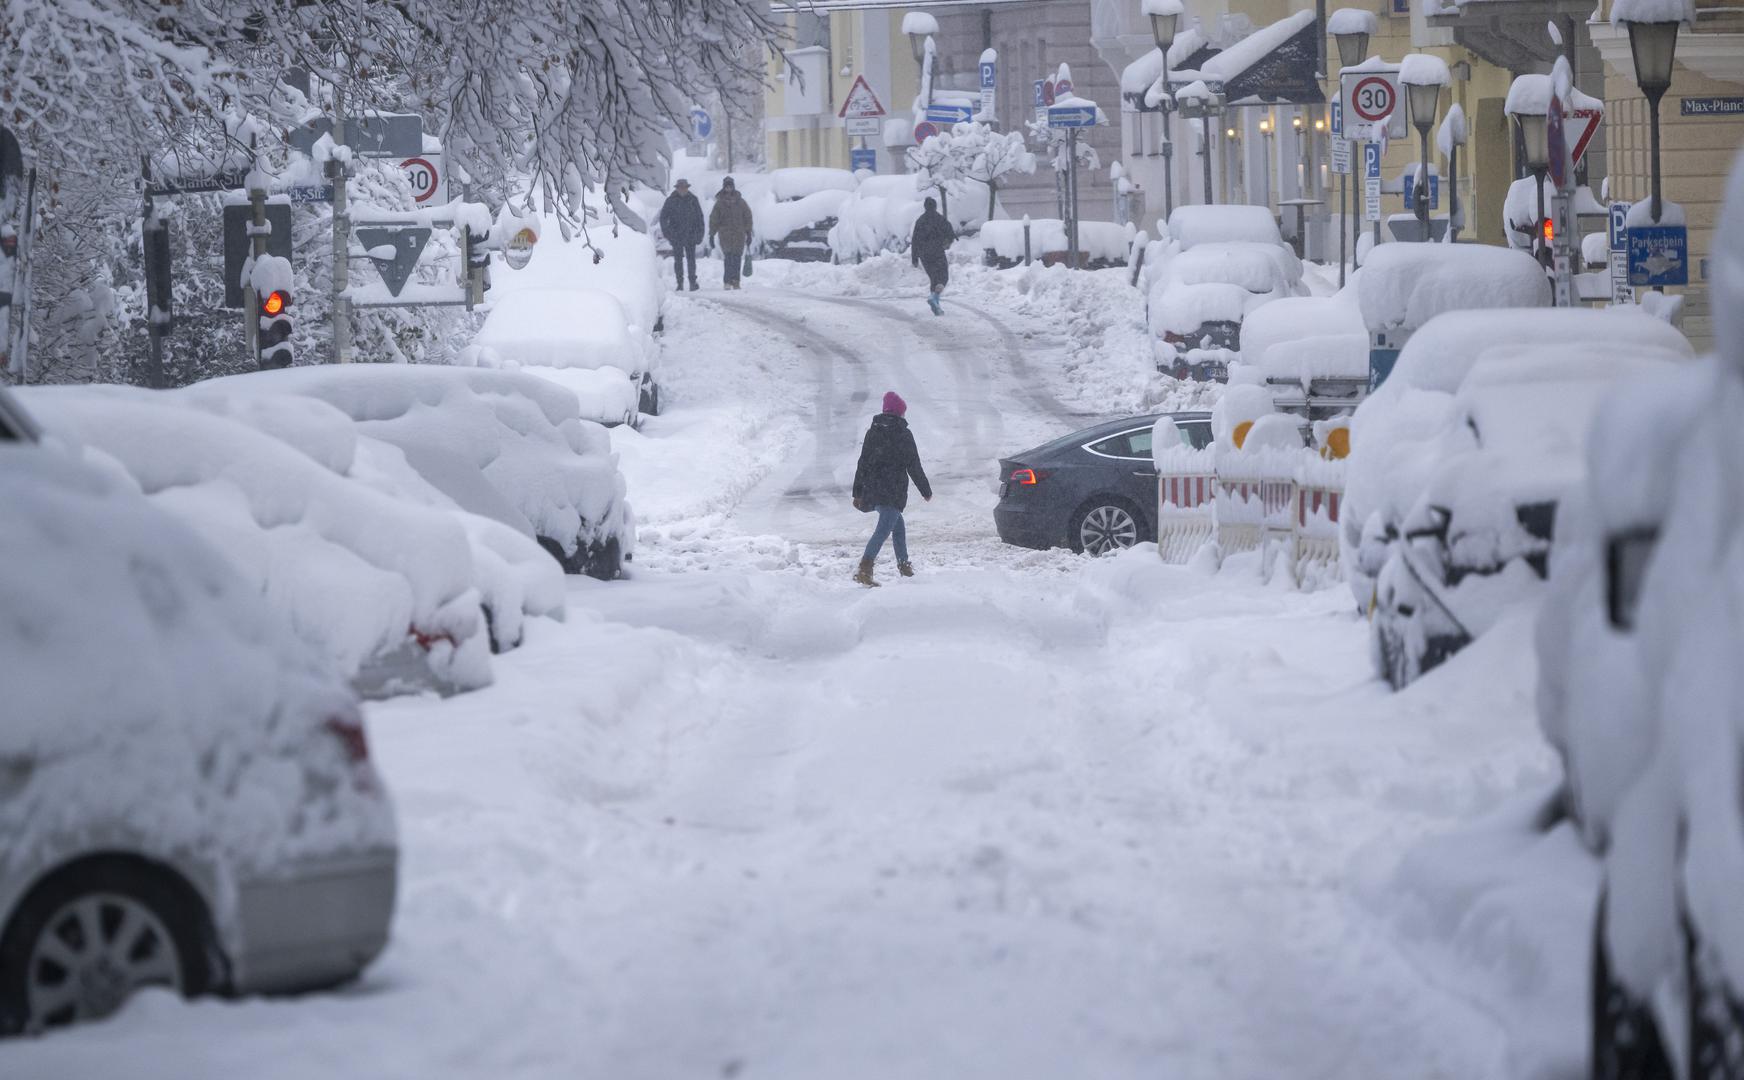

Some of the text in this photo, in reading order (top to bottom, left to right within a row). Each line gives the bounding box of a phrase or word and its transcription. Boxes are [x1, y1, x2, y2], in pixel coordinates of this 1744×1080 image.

[983, 65, 992, 85] P
[1361, 89, 1387, 109] 30
[1685, 100, 1744, 112] Max-Planc
[1366, 148, 1375, 173] P
[1613, 210, 1626, 245] P
[1632, 235, 1683, 248] Parkschein
